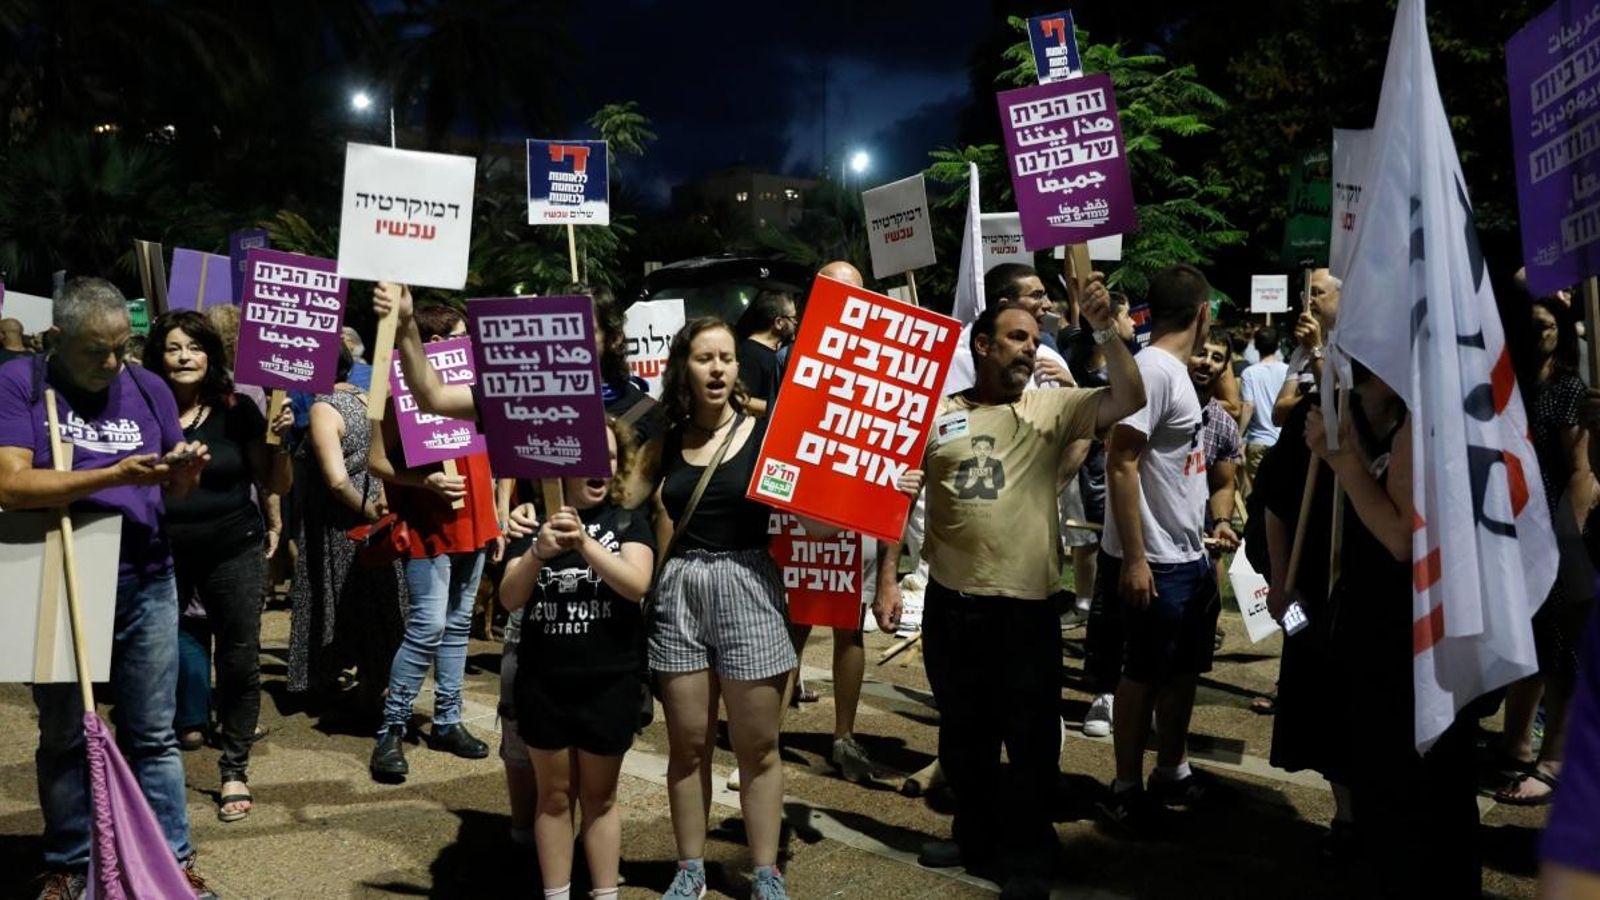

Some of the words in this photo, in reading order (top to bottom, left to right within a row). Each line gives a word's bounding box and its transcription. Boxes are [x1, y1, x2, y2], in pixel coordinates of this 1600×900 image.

[1041, 18, 1066, 46] די
[1014, 96, 1070, 124] הבית
[1077, 91, 1102, 111] זה
[1016, 125, 1068, 147] بيتنا
[1074, 117, 1114, 137] هذا
[548, 144, 590, 174] די
[1019, 146, 1073, 172] כולנו
[1081, 138, 1114, 160] של
[356, 192, 460, 220] דמוקרטיה
[543, 210, 569, 218] עכשיו
[570, 208, 594, 218] שלום
[375, 219, 436, 240] עכשיו
[872, 207, 922, 231] דמוקרטיה
[884, 227, 914, 243] עכשיו
[991, 246, 1018, 254] עכשיו
[257, 264, 308, 285] הבית
[315, 273, 338, 289] זה
[255, 284, 300, 308] بيتنا
[305, 291, 341, 311] هذا
[250, 305, 299, 325] כולנו
[306, 311, 334, 329] של
[840, 295, 949, 352] יהודים
[483, 318, 543, 338] הבית
[552, 317, 580, 336] זה
[445, 351, 464, 365] זה
[484, 344, 541, 370] بيتنا
[547, 344, 592, 365] هذا
[817, 326, 940, 389] וערבים
[442, 369, 474, 383] هذا
[486, 371, 546, 394] כולנו
[553, 370, 589, 392] של
[792, 355, 930, 423] מסרבים
[818, 402, 920, 456] להיות
[795, 431, 909, 491] אויבים
[791, 539, 856, 566] להיות
[783, 566, 856, 594] אויבים
[567, 600, 612, 621] YORK
